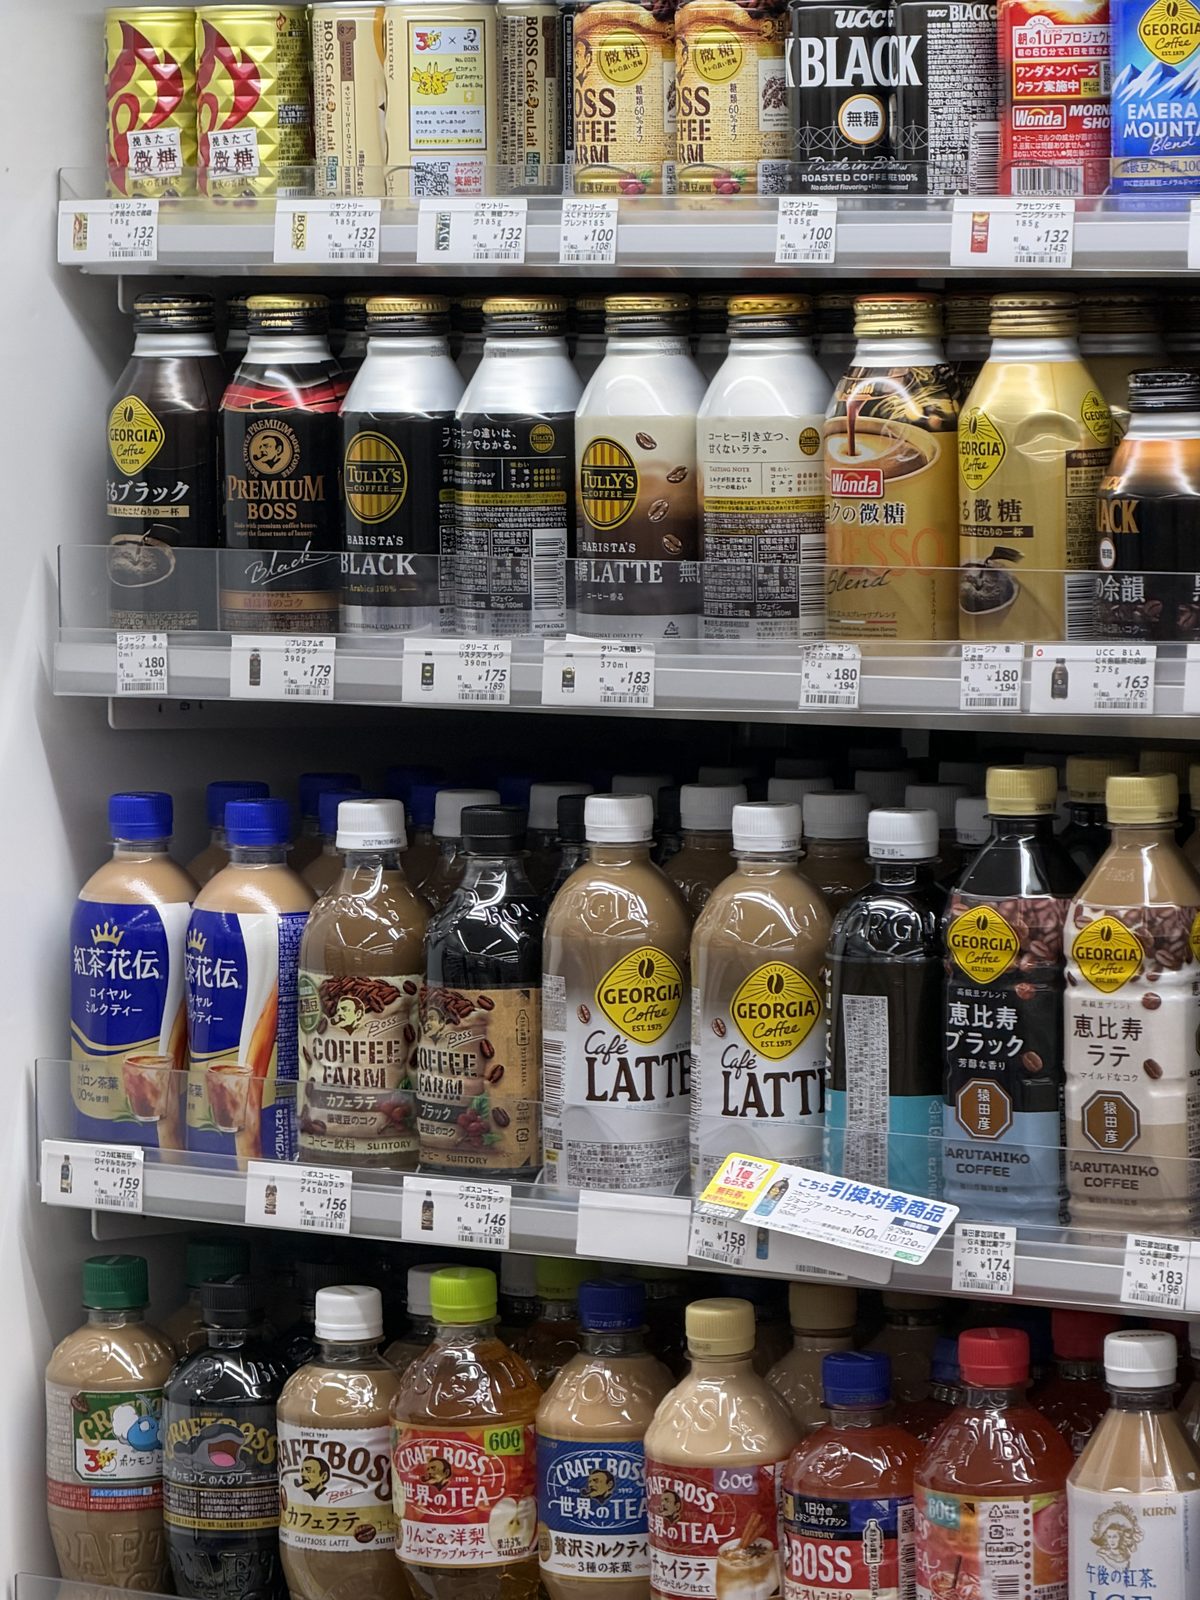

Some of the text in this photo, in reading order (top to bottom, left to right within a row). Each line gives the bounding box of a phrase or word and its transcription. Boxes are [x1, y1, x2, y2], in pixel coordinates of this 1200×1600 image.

[1155, 37, 1192, 50] Coffee
[604, 44, 641, 66] 微糖
[700, 42, 736, 64] 微糖
[1016, 64, 1098, 77] ワンダメンバーズ
[1016, 80, 1079, 93] クラブ実施中
[846, 110, 880, 128] 無糖
[1015, 109, 1062, 127] Wonda
[132, 132, 175, 147] 挽きたて
[212, 132, 252, 147] 挽きたて
[1150, 136, 1196, 155] Blend
[133, 148, 177, 174] 微糖
[214, 148, 255, 174] 微糖
[802, 173, 851, 183] ROASTED
[109, 428, 159, 442] GEORGIA
[708, 431, 790, 443] コーヒー引き立つ、
[116, 445, 146, 457] Coffee
[708, 443, 768, 455] 甘くないラテ。
[347, 465, 402, 484] TULLY'S
[963, 460, 990, 473] Coffee
[227, 475, 326, 501] PREMIUM
[582, 470, 635, 490] TULLY'S
[832, 475, 878, 493] Wonda
[248, 503, 298, 520] BOSS
[347, 535, 404, 546] BARISTA'S
[582, 542, 637, 553] BARISTA'S
[340, 554, 417, 576] BLACK
[590, 561, 663, 583] LATTE
[1096, 648, 1116, 656] UCC
[951, 934, 1014, 951] GEORGIA
[73, 945, 160, 980] 紅茶花伝
[965, 951, 1001, 965] Coffee
[1075, 946, 1138, 962] GEORGIA
[1089, 962, 1125, 977] Coffee
[90, 988, 132, 1001] ロイヤル
[603, 985, 681, 1005] GEORGIA
[86, 1003, 143, 1017] ミルクティー
[622, 1006, 670, 1024] Coffee
[737, 1001, 816, 1019] GEORGIA
[948, 1002, 1019, 1031] 恵比寿
[752, 1021, 801, 1038] Coffee
[1073, 1014, 1143, 1042] 恵比寿
[312, 1037, 401, 1064] COFFEE
[584, 1030, 628, 1064] Café
[945, 1031, 1024, 1058] ブラック
[721, 1044, 757, 1079] Café
[1087, 1045, 1131, 1067] ラテ
[322, 1067, 387, 1088] FARM
[419, 1073, 464, 1095] FARM
[1079, 1071, 1139, 1083] マイルドなコク
[326, 1094, 378, 1111] カフェラテ
[421, 1103, 451, 1120] ブラック
[308, 1136, 356, 1150] コーヒー飲料
[956, 1163, 1011, 1178] COFFEE
[723, 1176, 755, 1190] もらえる
[1083, 1176, 1140, 1191] COFFEE
[399, 1445, 490, 1477] CRAFT BOSS
[556, 1458, 603, 1486] CRAFT
[403, 1481, 490, 1508] 世界のTEA
[673, 1483, 719, 1514] BOSS
[288, 1506, 360, 1532] カフェラテ
[1142, 1506, 1177, 1517] KIRIN
[329, 1538, 350, 1547] LATTE
[406, 1527, 487, 1546] りんご&洋梨
[405, 1545, 494, 1561] ゴールドアップルティー
[577, 1562, 633, 1573] 3種の茶葉
[652, 1554, 711, 1582] チャイラテ
[791, 1542, 853, 1584] BOSS
[1086, 1562, 1155, 1587] 午後の紅茶
